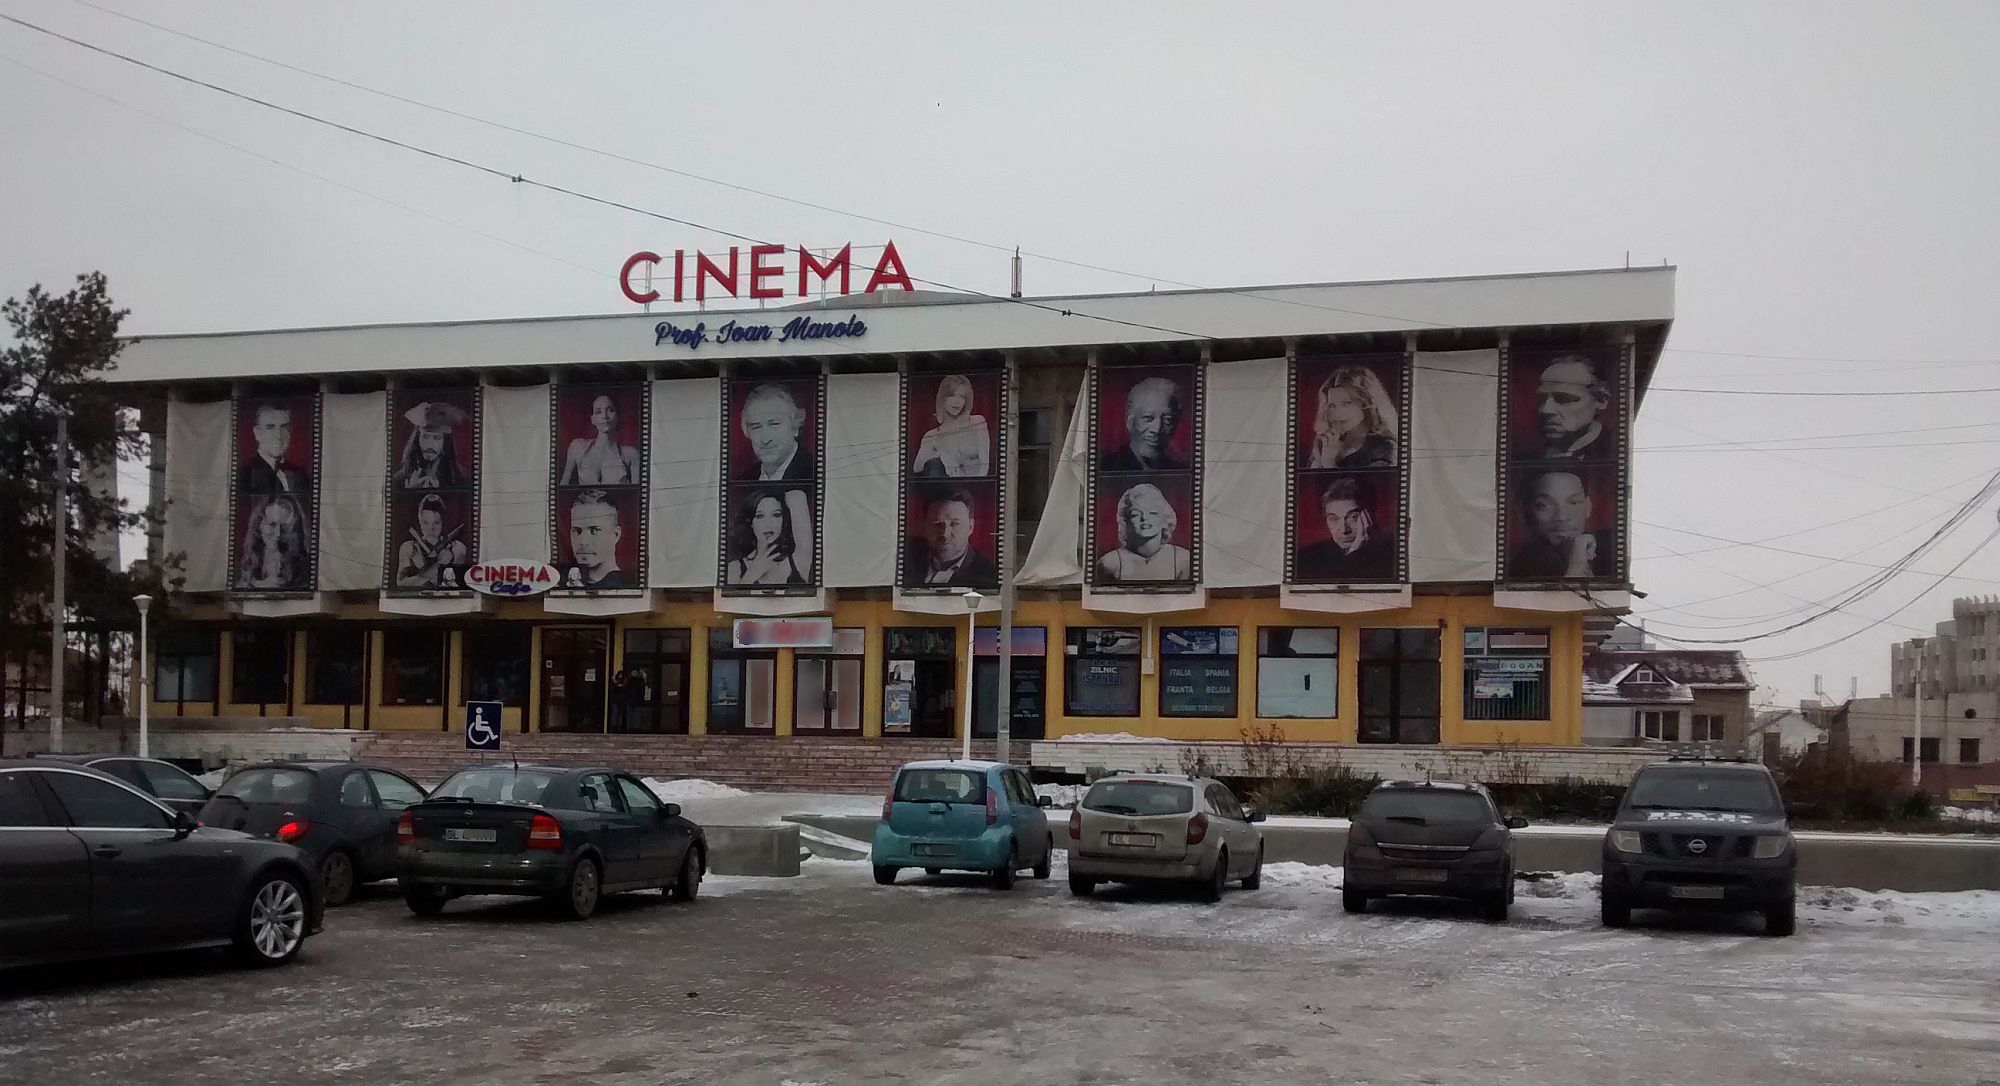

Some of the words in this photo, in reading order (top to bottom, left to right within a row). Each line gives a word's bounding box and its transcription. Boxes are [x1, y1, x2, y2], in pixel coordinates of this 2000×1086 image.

[620, 238, 915, 304] CINEMA
[655, 322, 709, 349] Prof.
[716, 321, 772, 343] Ioan
[778, 313, 867, 343] Manole
[470, 565, 551, 582] CINEMA
[1090, 666, 1118, 674] ZILNIC
[1169, 668, 1192, 677] ITALIA
[1204, 669, 1230, 677] SPANIA
[1166, 686, 1194, 694] FRANTA
[1206, 686, 1231, 694] BELGIA
